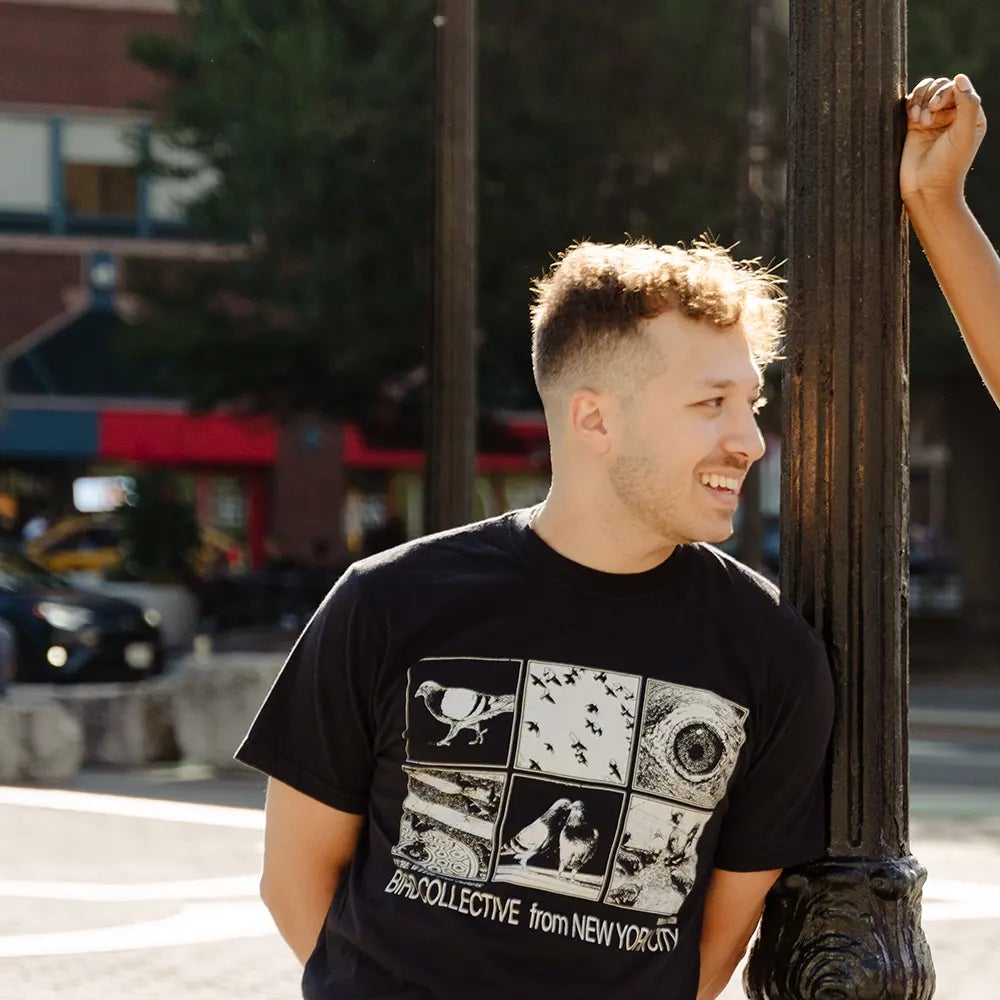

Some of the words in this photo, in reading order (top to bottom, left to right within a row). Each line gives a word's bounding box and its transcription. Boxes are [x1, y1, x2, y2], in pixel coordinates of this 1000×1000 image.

[529, 901, 569, 937] from
[571, 912, 615, 947] NEW
[647, 926, 679, 953] CITY
